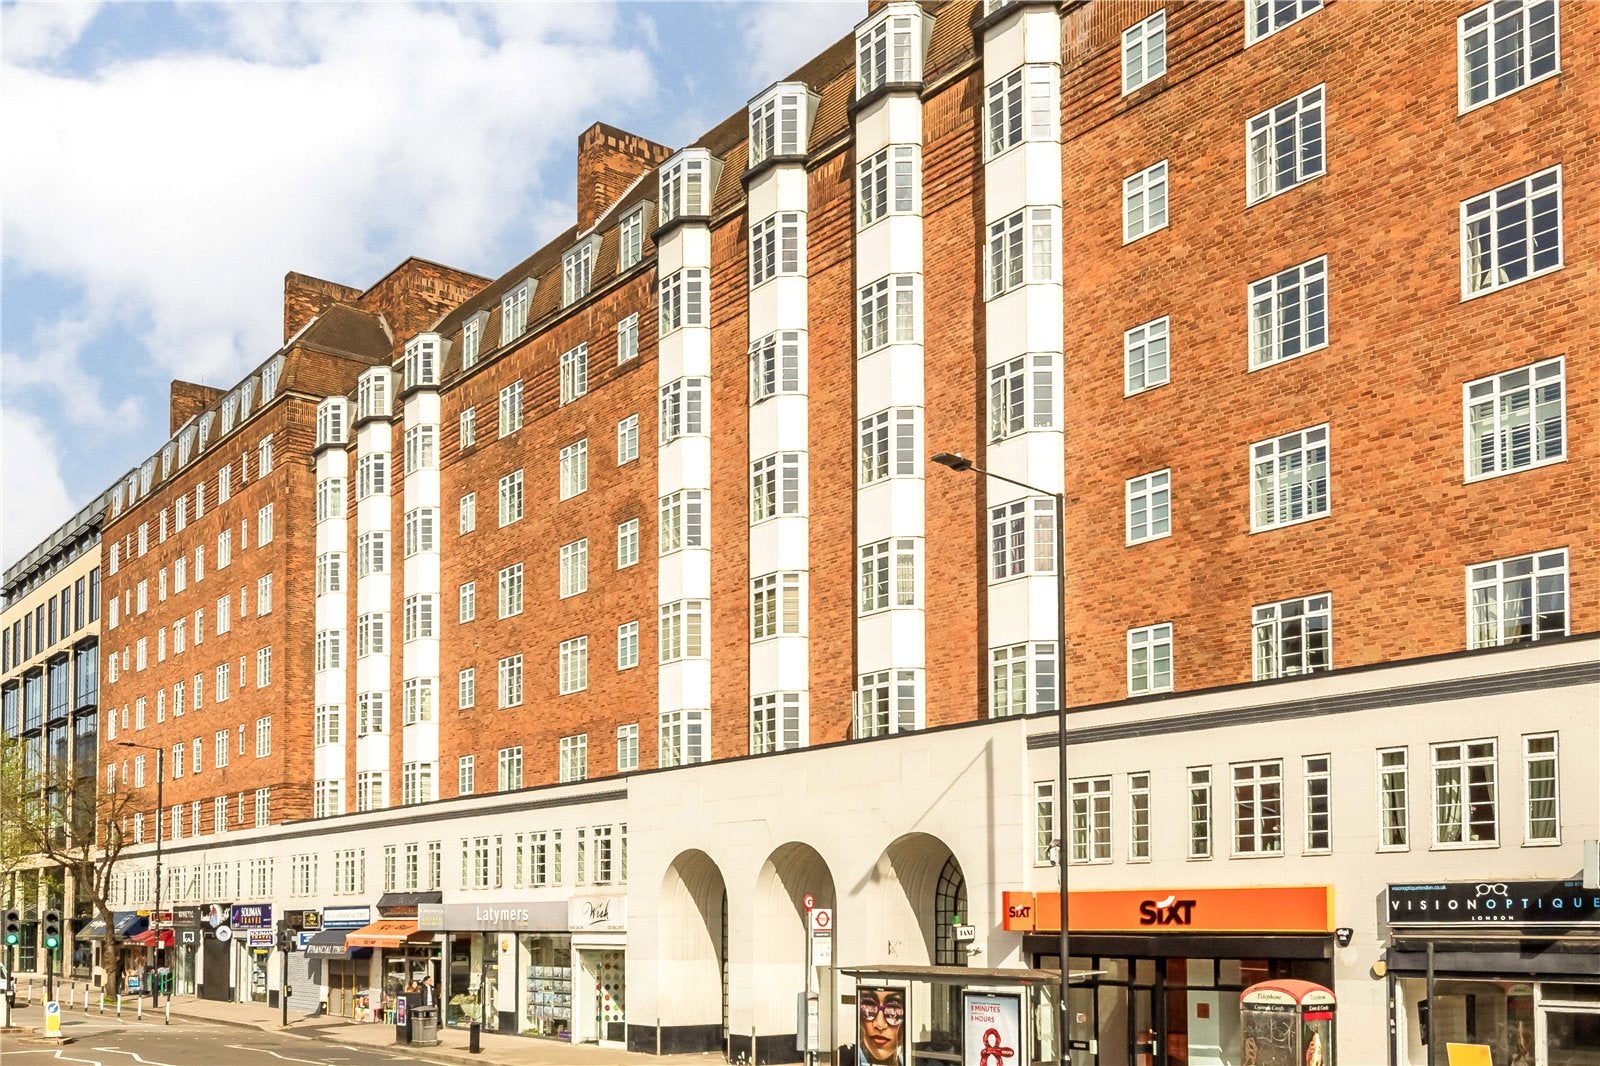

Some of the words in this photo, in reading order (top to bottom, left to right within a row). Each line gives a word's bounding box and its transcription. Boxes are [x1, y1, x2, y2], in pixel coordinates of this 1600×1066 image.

[805, 896, 813, 908] G
[582, 899, 611, 920] Wish
[241, 916, 262, 924] TRAVEL
[476, 906, 529, 925] Latymers
[306, 945, 332, 954] FINANCIAL
[975, 1005, 1001, 1013] MINUTES
